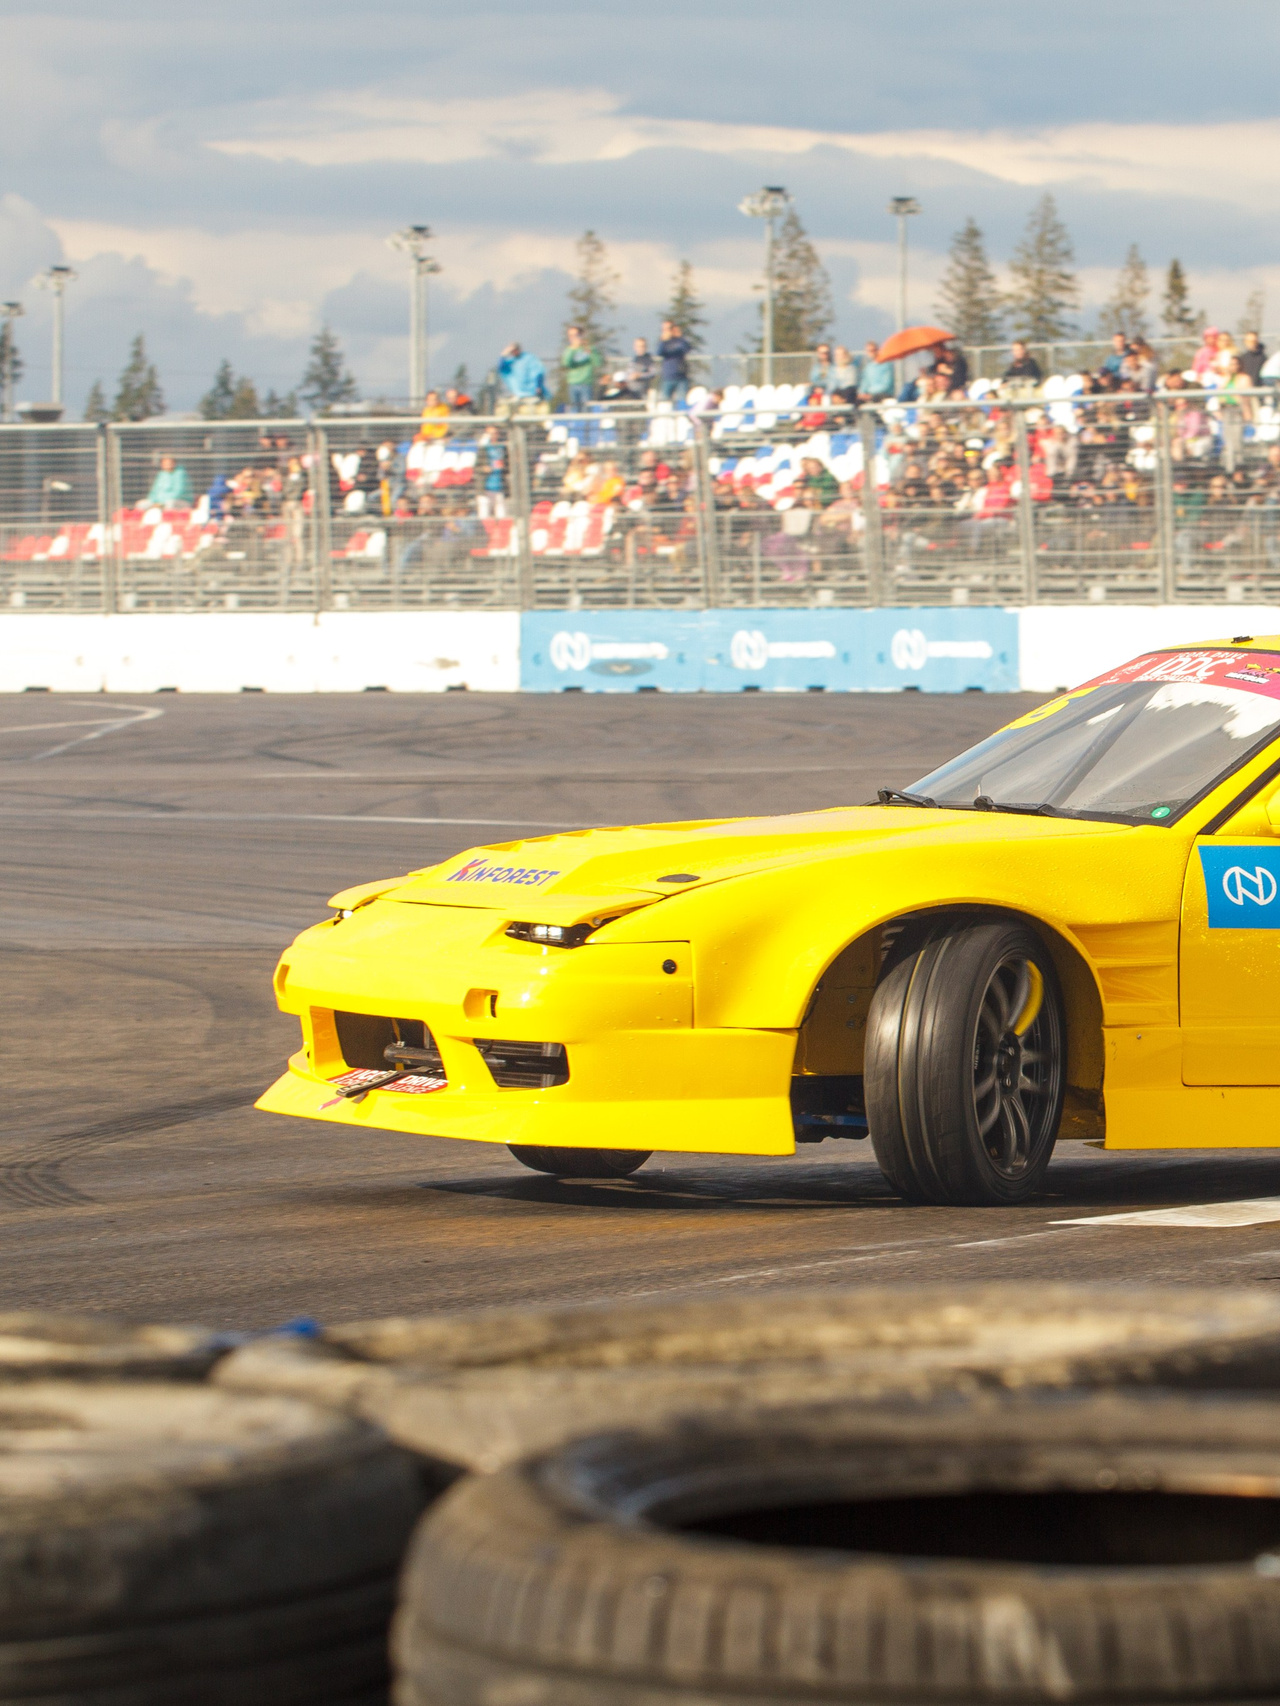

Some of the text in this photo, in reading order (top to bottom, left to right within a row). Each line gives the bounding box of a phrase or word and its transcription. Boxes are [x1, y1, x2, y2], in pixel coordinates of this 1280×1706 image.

[1210, 652, 1249, 660] DRIVE
[446, 858, 561, 887] KINFOREST
[396, 1074, 450, 1089] DRIVE
